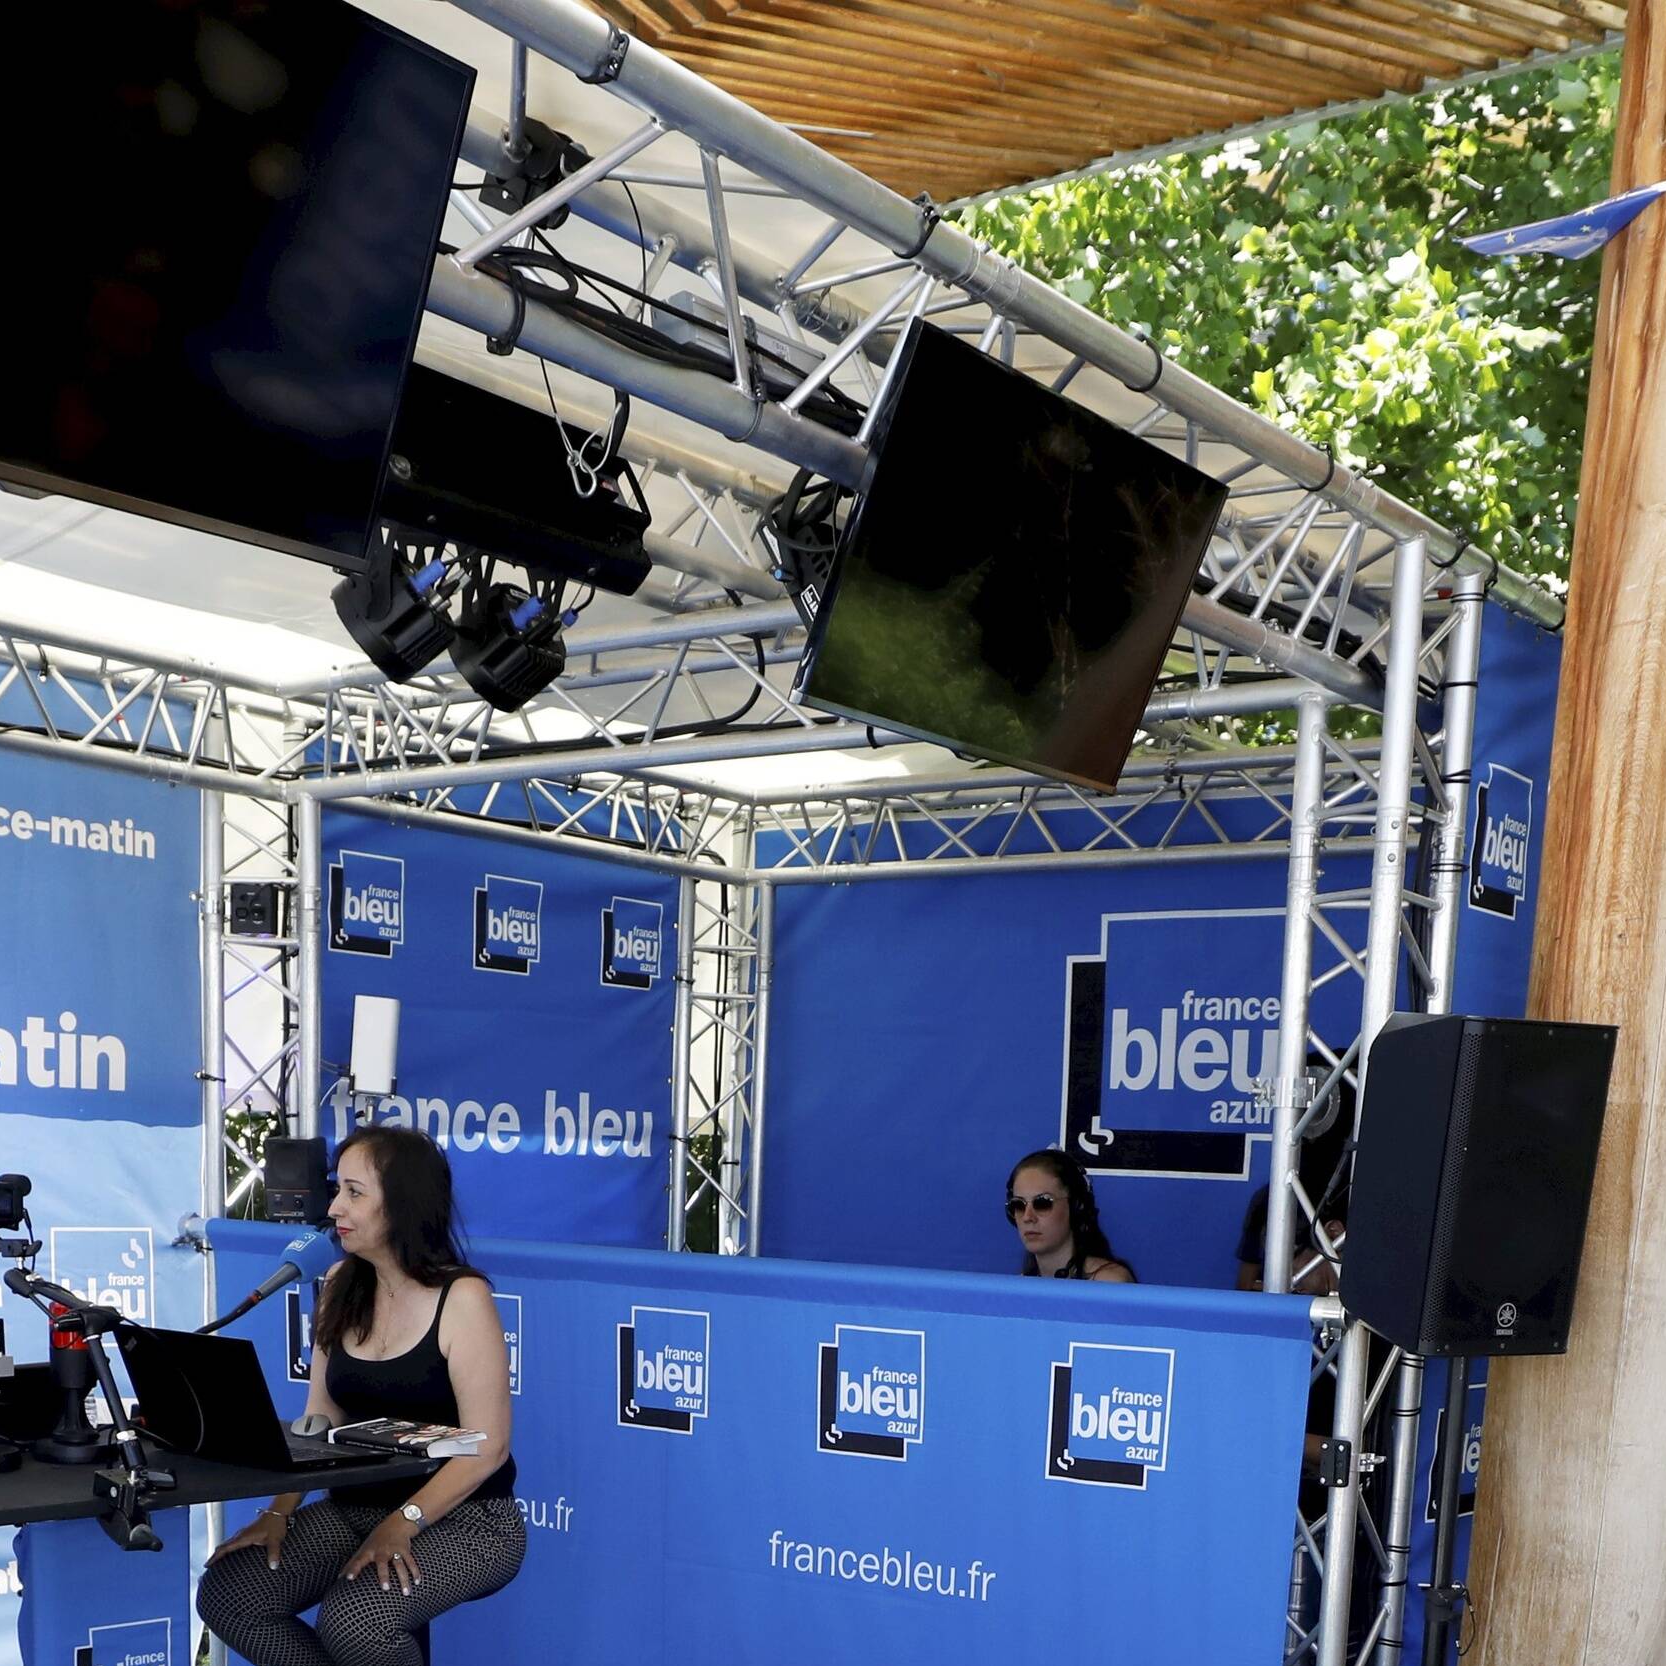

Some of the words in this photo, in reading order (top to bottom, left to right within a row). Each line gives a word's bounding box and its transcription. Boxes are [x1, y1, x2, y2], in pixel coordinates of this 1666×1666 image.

[1505, 813, 1526, 837] france
[1482, 816, 1524, 874] bleu
[368, 883, 399, 900] france
[1507, 875, 1523, 891] azur
[343, 887, 399, 926] bleu
[508, 906, 536, 921] france
[378, 926, 399, 938] azur
[488, 909, 536, 945] bleu
[633, 925, 658, 939] france
[517, 945, 536, 956] azur
[613, 929, 658, 962] bleu
[640, 962, 657, 973] azur
[1182, 990, 1281, 1021] france
[1109, 1008, 1281, 1092] bleu
[330, 1077, 521, 1153] fance
[543, 1089, 654, 1157] bleu
[108, 1272, 145, 1286] france
[664, 1344, 703, 1363] france
[637, 1350, 703, 1395] bleu
[872, 1366, 917, 1385] france
[675, 1395, 702, 1410] azur
[839, 1371, 917, 1420] bleu
[1112, 1387, 1163, 1407] france
[887, 1420, 917, 1435] azur
[1071, 1393, 1162, 1445] bleu
[1125, 1444, 1159, 1462] azur
[769, 1530, 997, 1602] francebleu.fr
[125, 1650, 165, 1666] france
